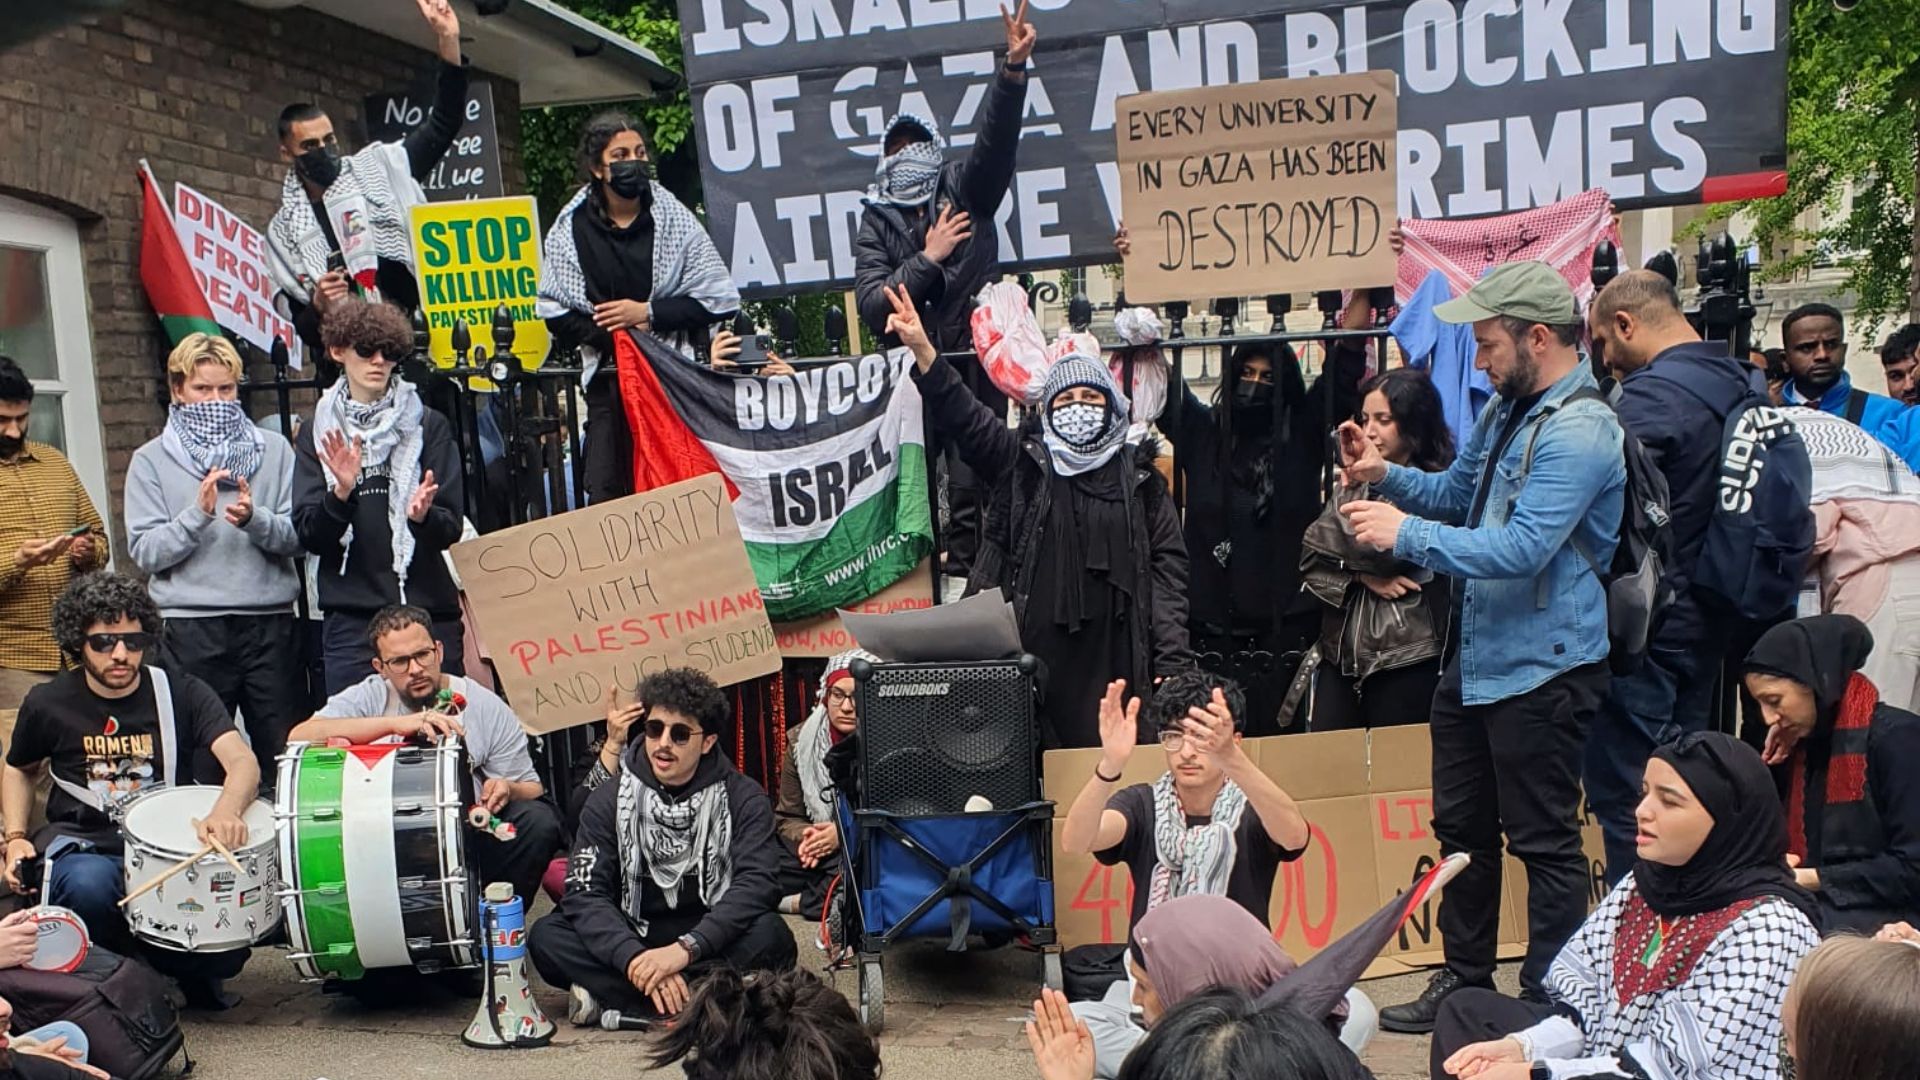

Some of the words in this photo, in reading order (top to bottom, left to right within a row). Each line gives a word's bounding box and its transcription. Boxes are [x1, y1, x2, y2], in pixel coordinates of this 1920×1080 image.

[703, 75, 800, 172] OF
[1091, 21, 1260, 131] AND
[1286, 0, 1776, 94] BLOCKING
[1129, 105, 1207, 142] EVERY
[1219, 94, 1377, 130] UNIVERSITY
[451, 166, 484, 185] we
[1137, 160, 1162, 192] IN
[1179, 151, 1254, 188] GAZA
[1270, 146, 1320, 181] HAS
[1327, 140, 1386, 176] BEEN
[1397, 96, 1708, 220] RIMES
[178, 187, 267, 265] DIVE
[421, 216, 532, 268] STOP
[1157, 196, 1380, 271] DESTROYED
[425, 266, 538, 305] KILLING
[431, 303, 542, 329] PALESTIAN
[478, 485, 723, 598] SOLIDARITY
[568, 569, 659, 622] WITH
[510, 588, 764, 676] PALESTINIANS
[534, 671, 601, 714] AND
[879, 682, 950, 698] SOUNDBOKS
[1377, 798, 1435, 841] LI
